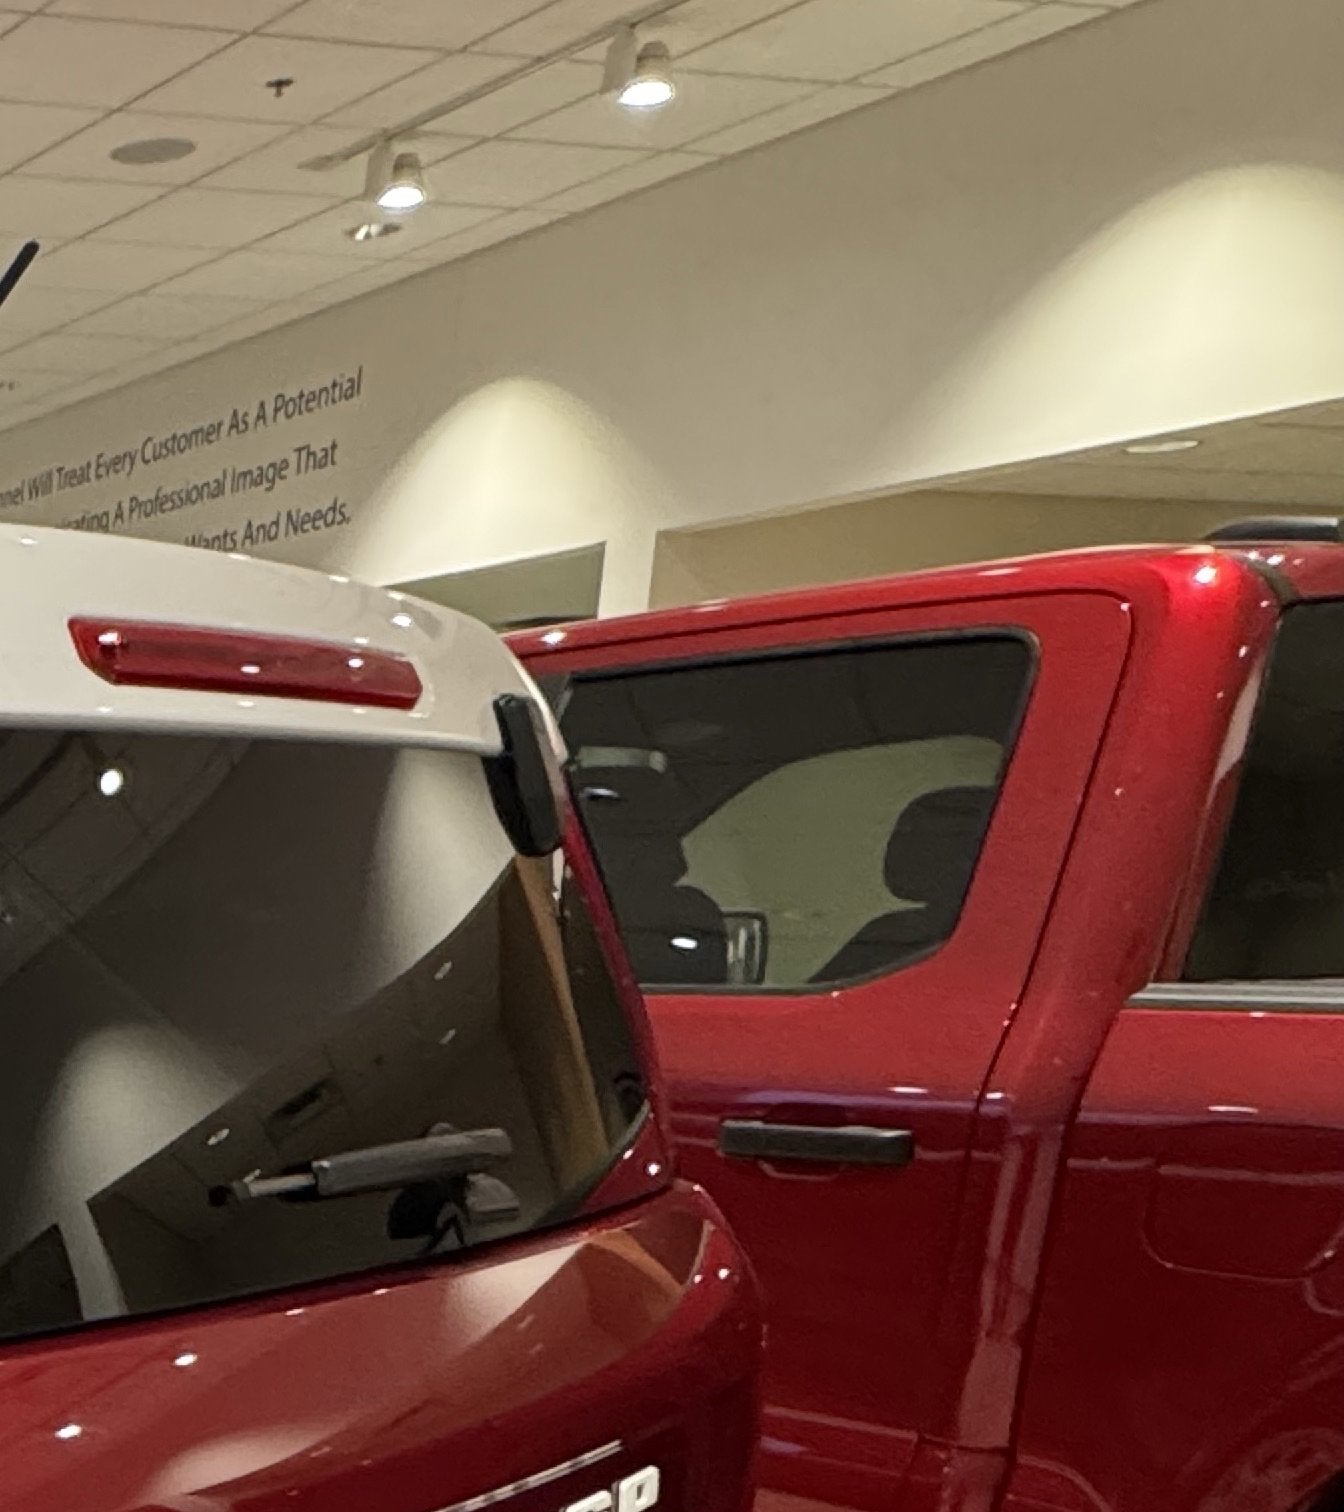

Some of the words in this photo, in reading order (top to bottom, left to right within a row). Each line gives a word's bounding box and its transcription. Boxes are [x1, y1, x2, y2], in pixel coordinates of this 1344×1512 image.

[27, 468, 53, 500] Will
[56, 461, 92, 491] Treat
[95, 446, 136, 482] Every
[141, 419, 223, 465] Customer
[227, 408, 250, 438] As
[254, 400, 268, 428] A
[272, 366, 363, 423] Potential
[112, 500, 125, 527] A
[128, 468, 226, 520] Professional
[230, 458, 290, 494] Image
[293, 438, 338, 476] That
[241, 510, 281, 547] And
[284, 498, 352, 538] Needs.
